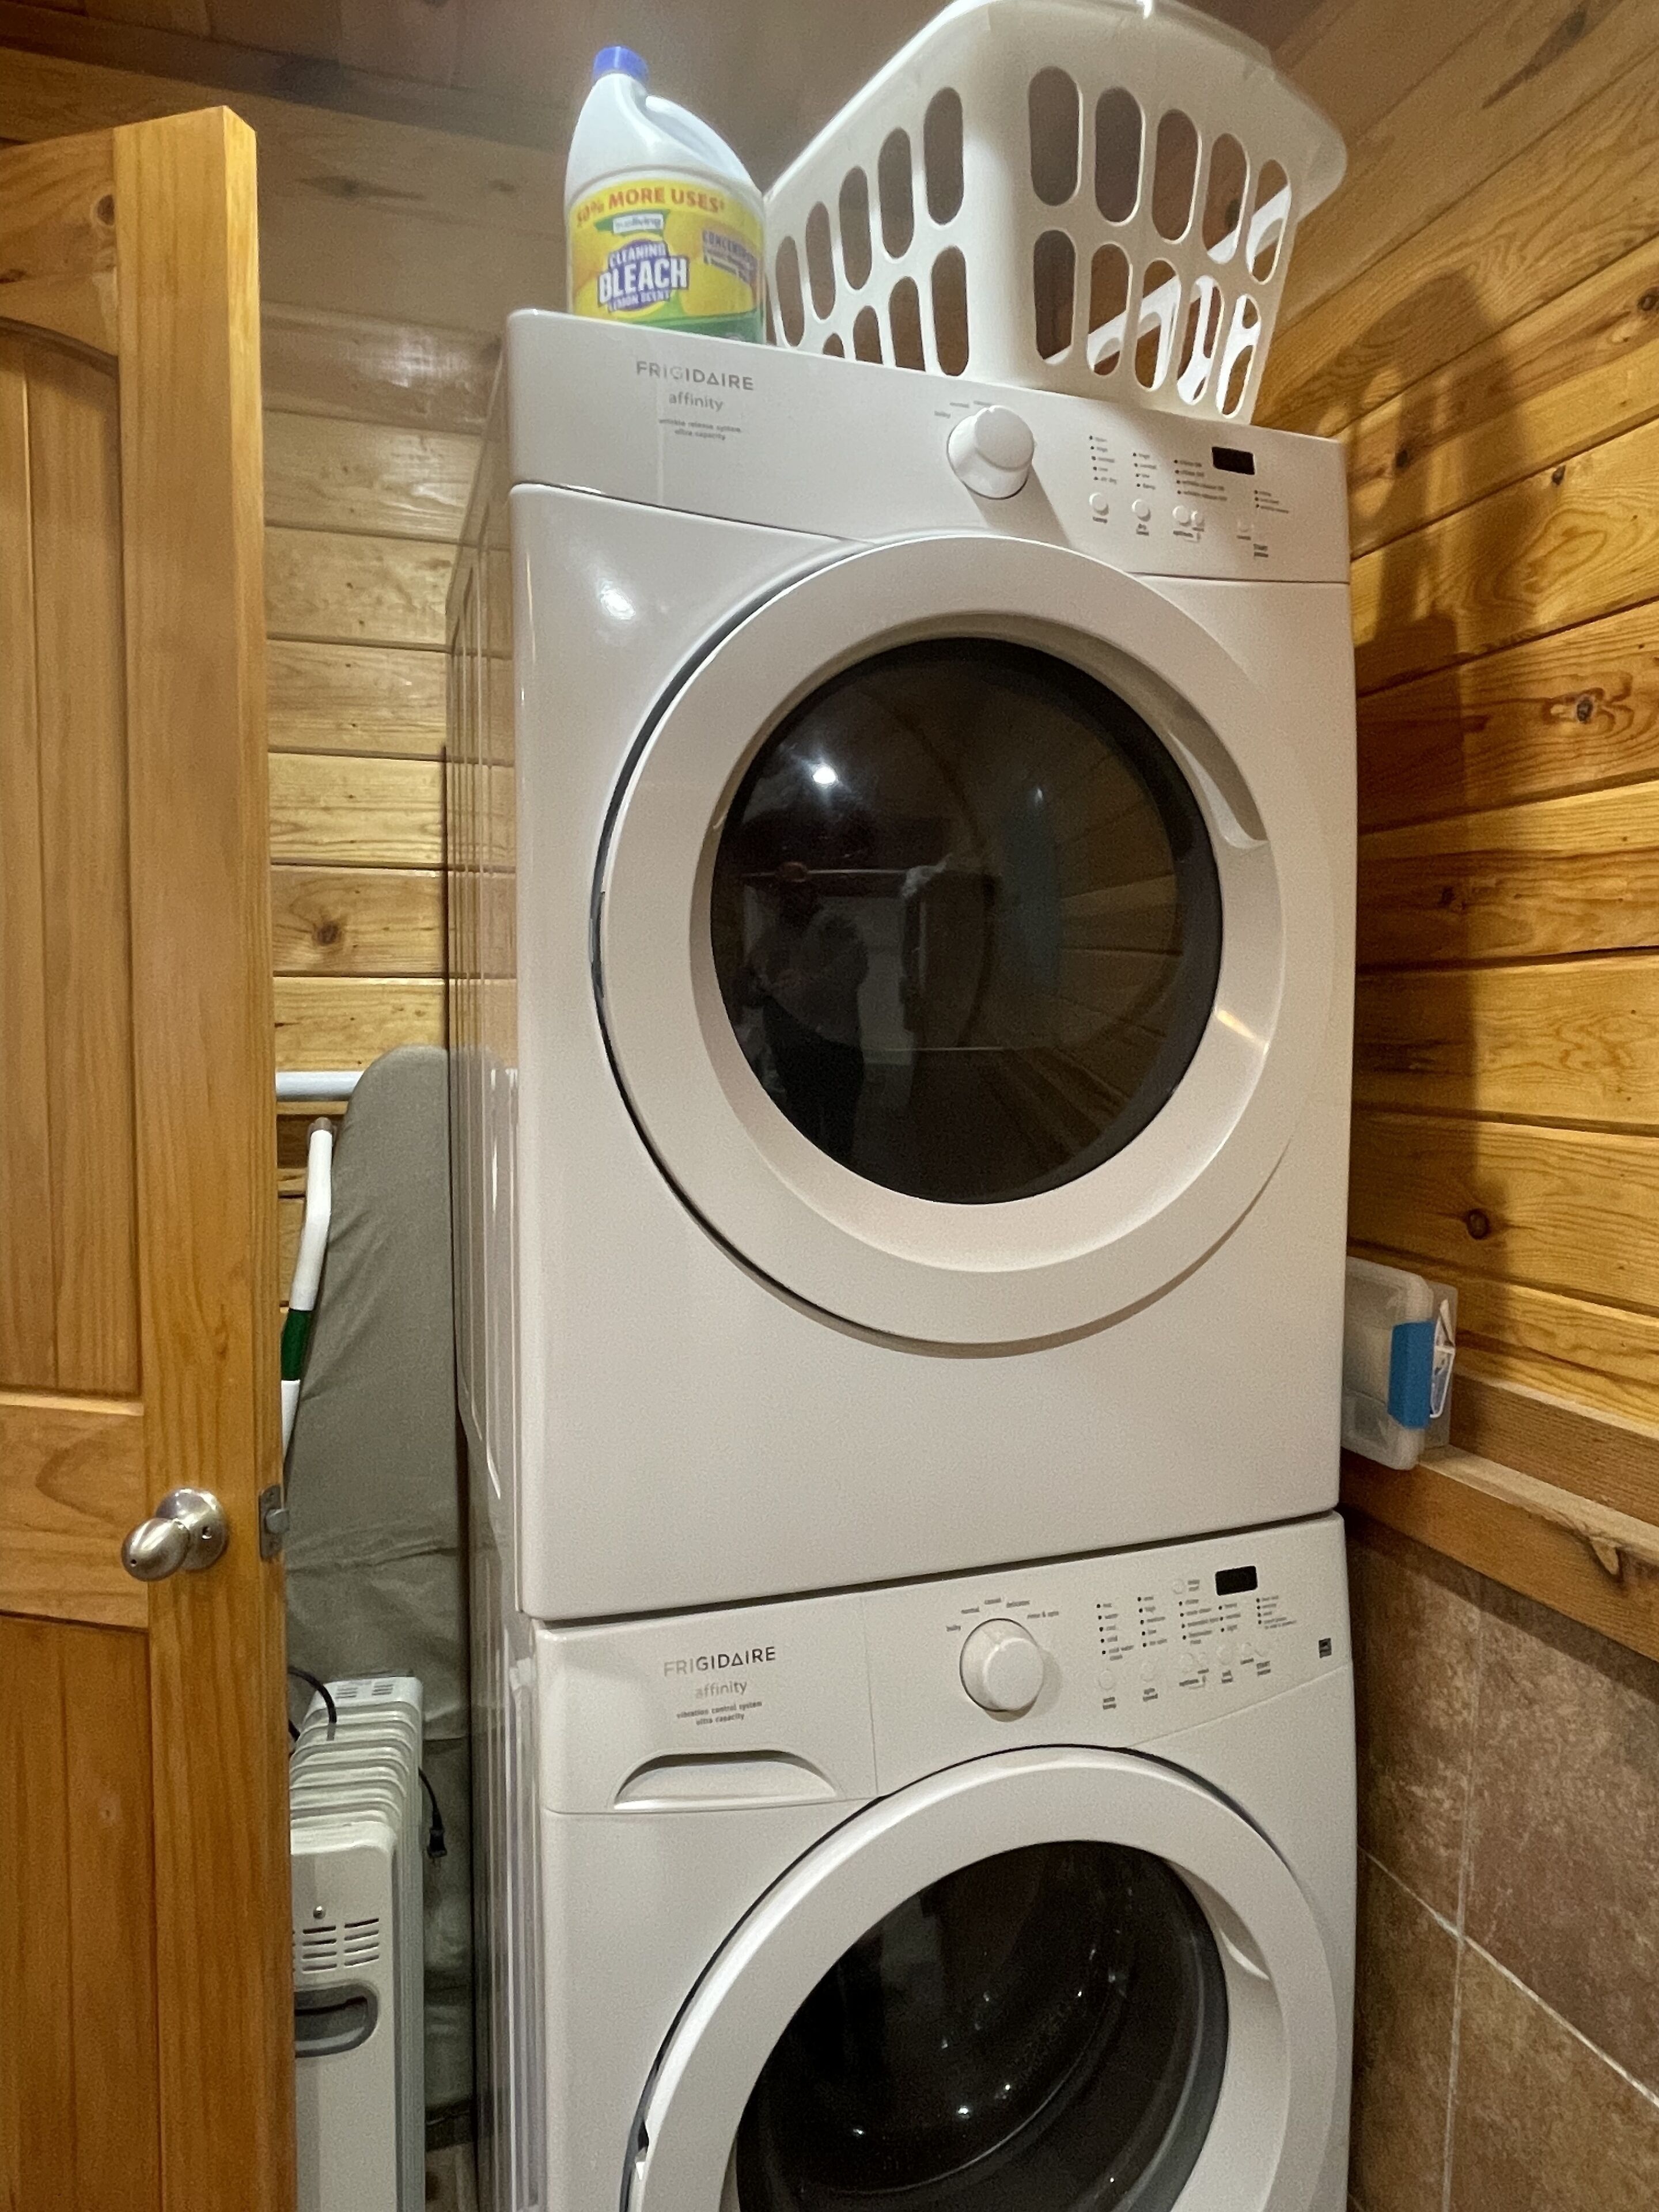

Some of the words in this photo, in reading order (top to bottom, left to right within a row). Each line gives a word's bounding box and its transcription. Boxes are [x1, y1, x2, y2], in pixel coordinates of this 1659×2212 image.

[608, 187, 665, 209] MORE
[599, 257, 687, 303] BLEACH
[636, 361, 754, 391] FRIGIDAIRE
[668, 392, 724, 412] affinity
[664, 1646, 776, 1677] FRIGIDAIRE
[695, 1681, 748, 1699] affinity
